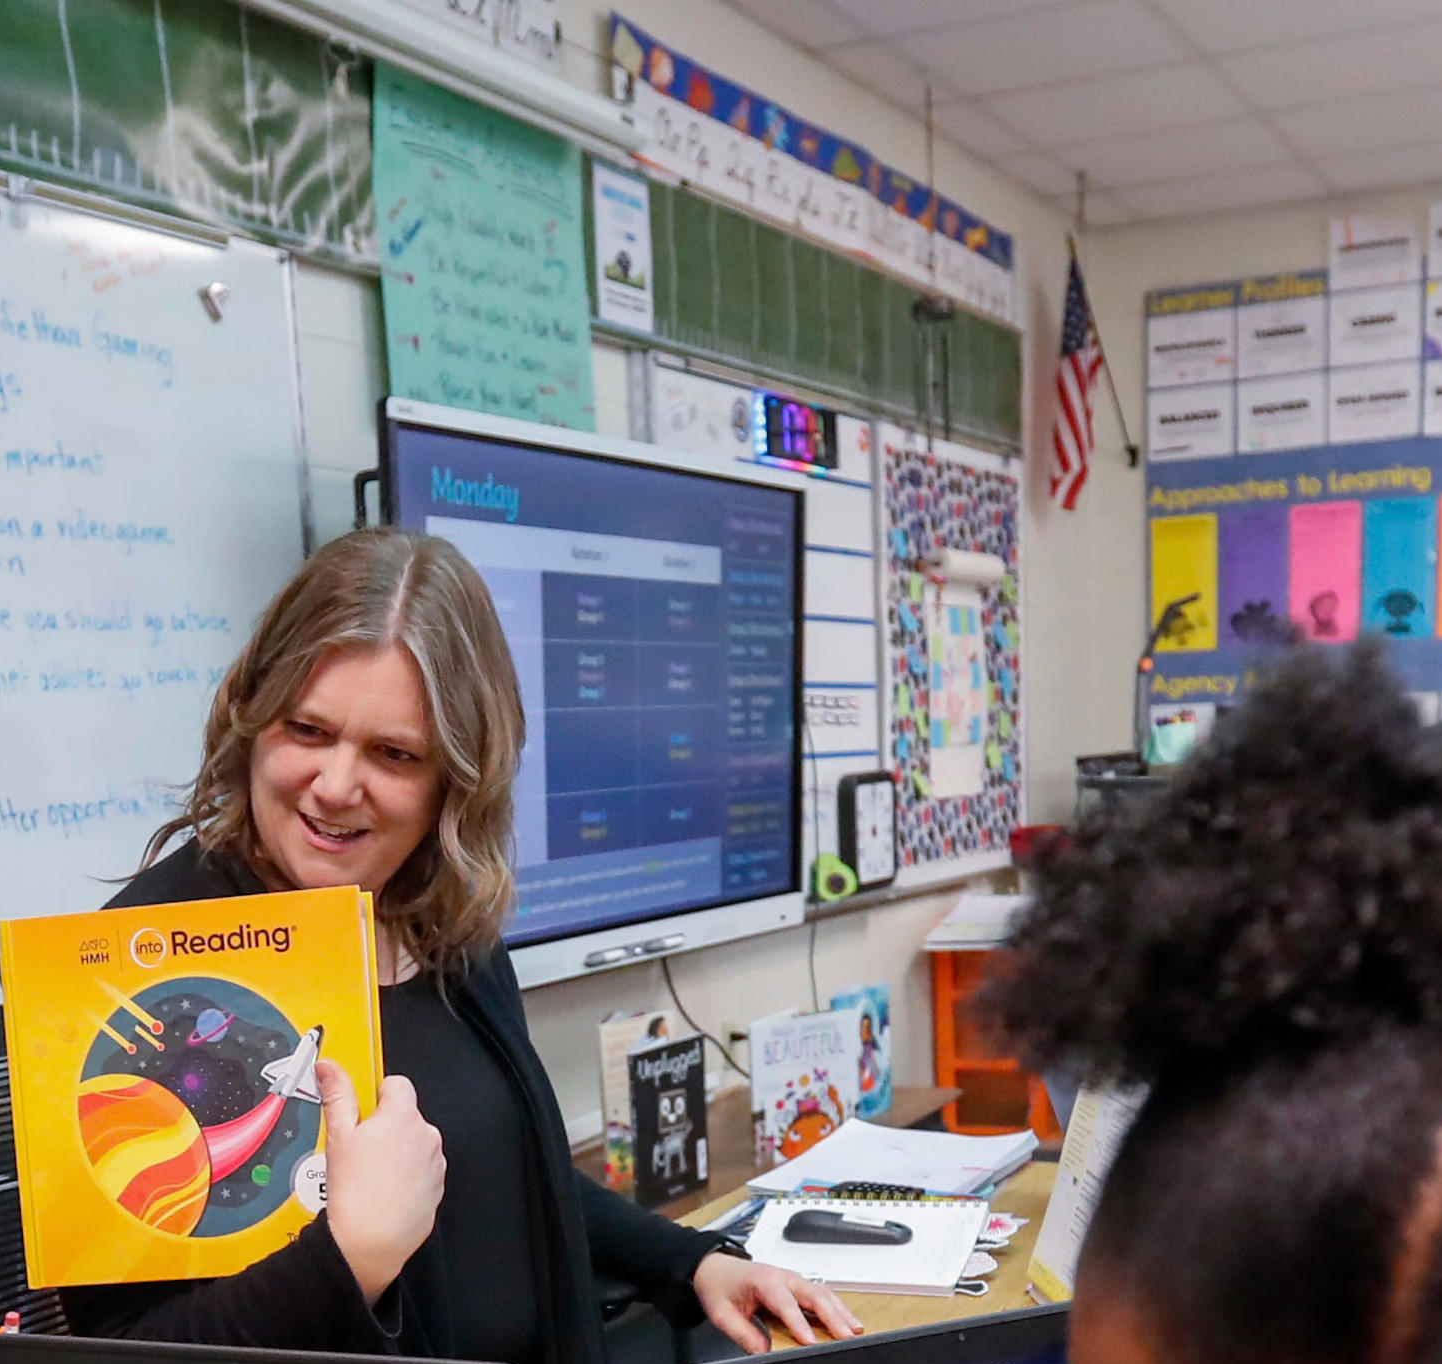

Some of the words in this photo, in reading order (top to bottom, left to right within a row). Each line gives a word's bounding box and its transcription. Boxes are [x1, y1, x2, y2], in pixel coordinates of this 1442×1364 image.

[431, 464, 521, 523] Monday
[1149, 477, 1288, 511] Approaches
[1297, 473, 1323, 496] to
[1328, 465, 1432, 493] Learning
[1151, 673, 1239, 698] Agency
[135, 939, 163, 955] into
[171, 924, 291, 957] Reading
[80, 951, 110, 966] HMH
[637, 1041, 701, 1084] Unplugged
[763, 1030, 846, 1067] BEAUTIFUL
[306, 1169, 327, 1180] Gra
